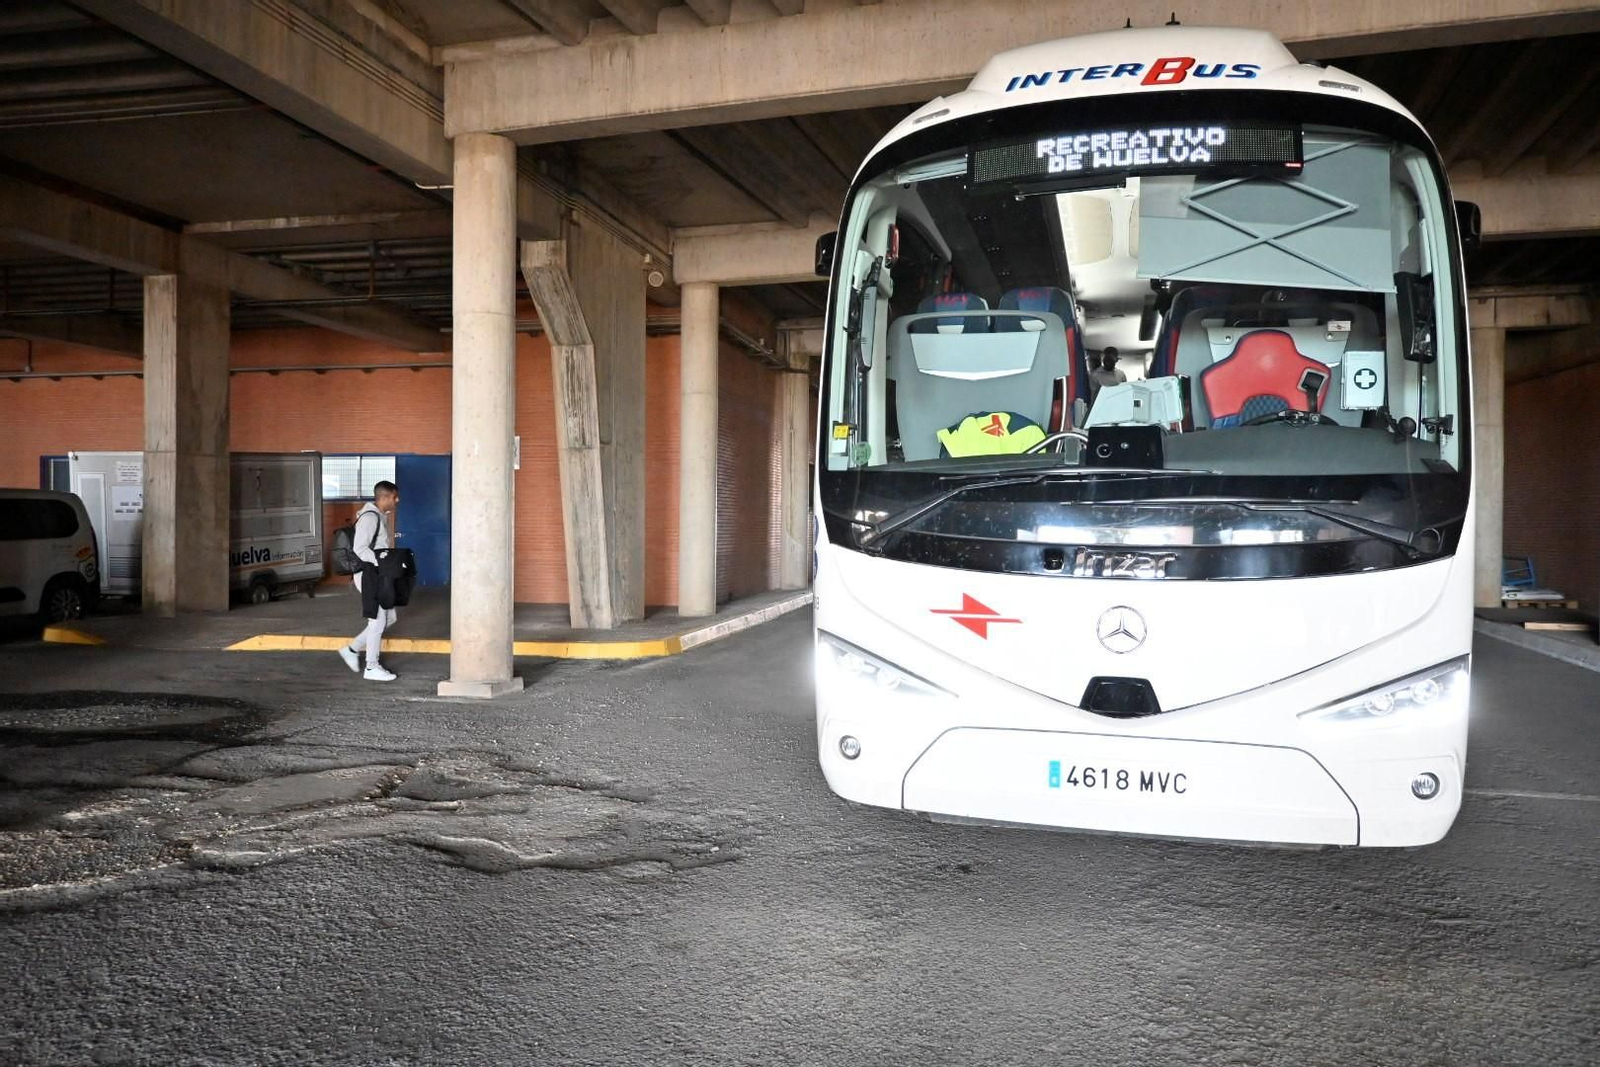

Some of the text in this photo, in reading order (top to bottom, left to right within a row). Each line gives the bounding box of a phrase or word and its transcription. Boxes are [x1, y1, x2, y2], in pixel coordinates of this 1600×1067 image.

[1004, 56, 1262, 93] INTERBUS
[1036, 127, 1226, 158] RECREATIVO
[1048, 145, 1211, 173] DE HUELVA
[229, 546, 270, 566] uelva
[1066, 765, 1187, 794] 4618 MVC
